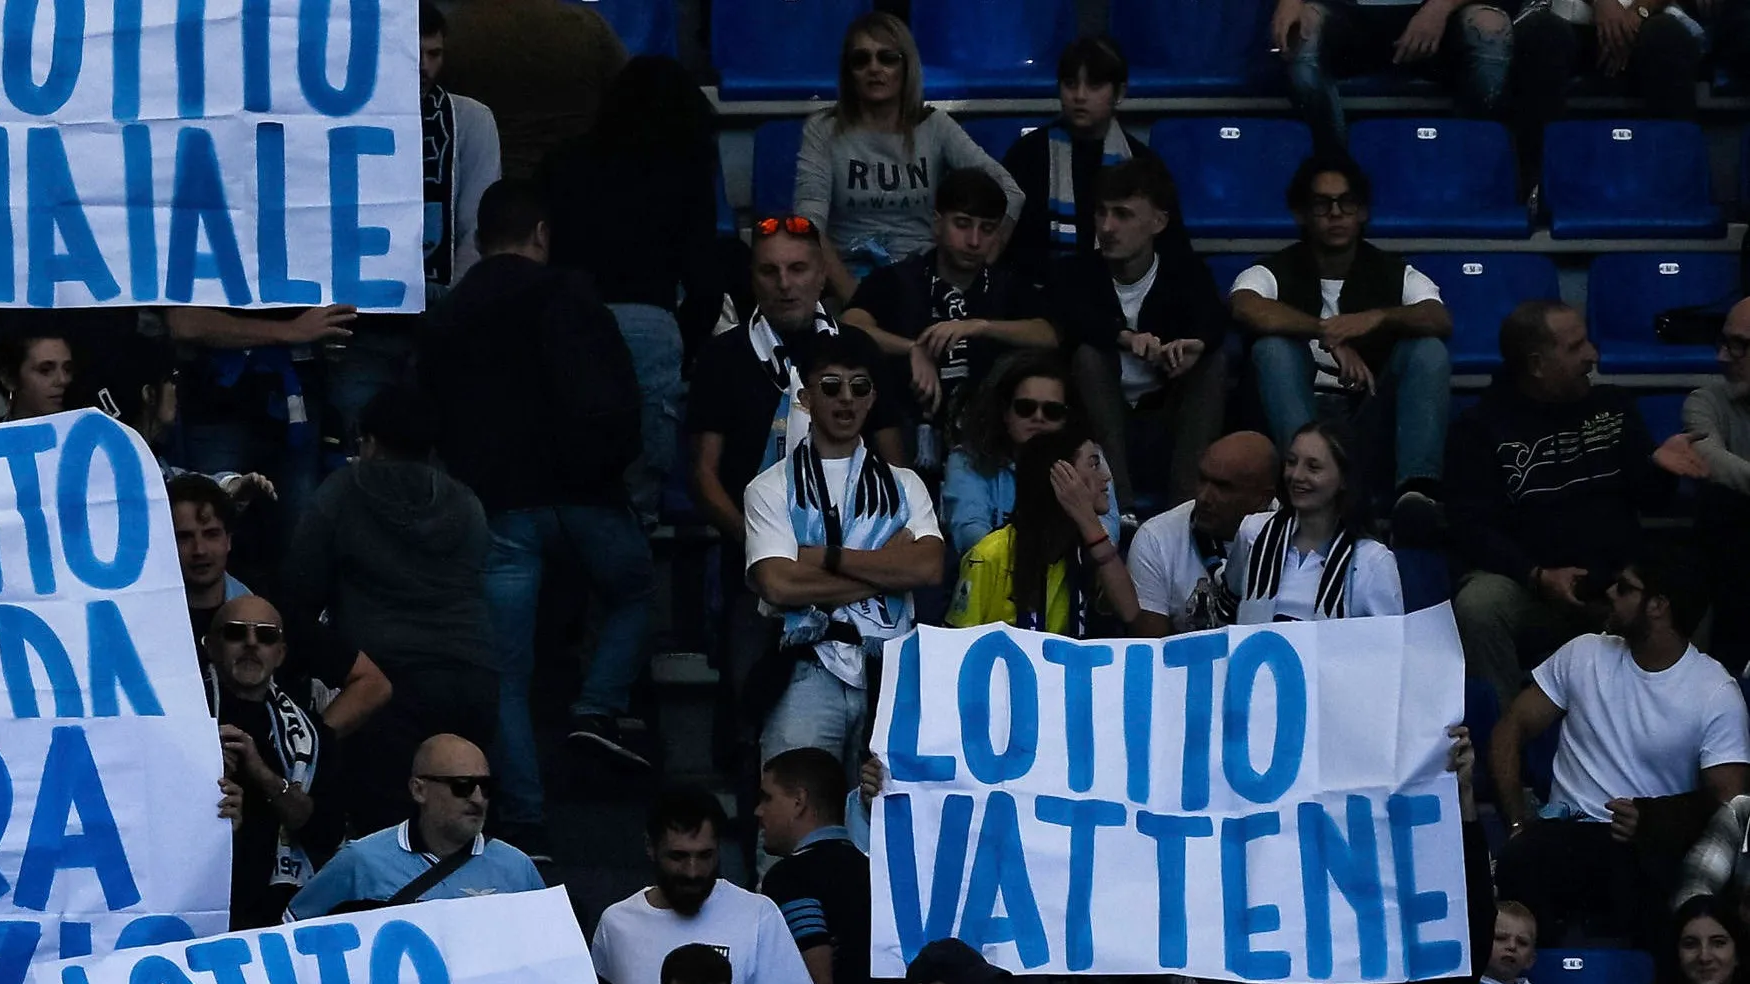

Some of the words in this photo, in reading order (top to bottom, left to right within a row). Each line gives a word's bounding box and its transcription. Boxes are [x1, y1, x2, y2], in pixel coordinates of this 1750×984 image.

[848, 157, 929, 191] RUN
[886, 630, 1307, 812] LOTITO
[884, 790, 1464, 983] VATTENE
